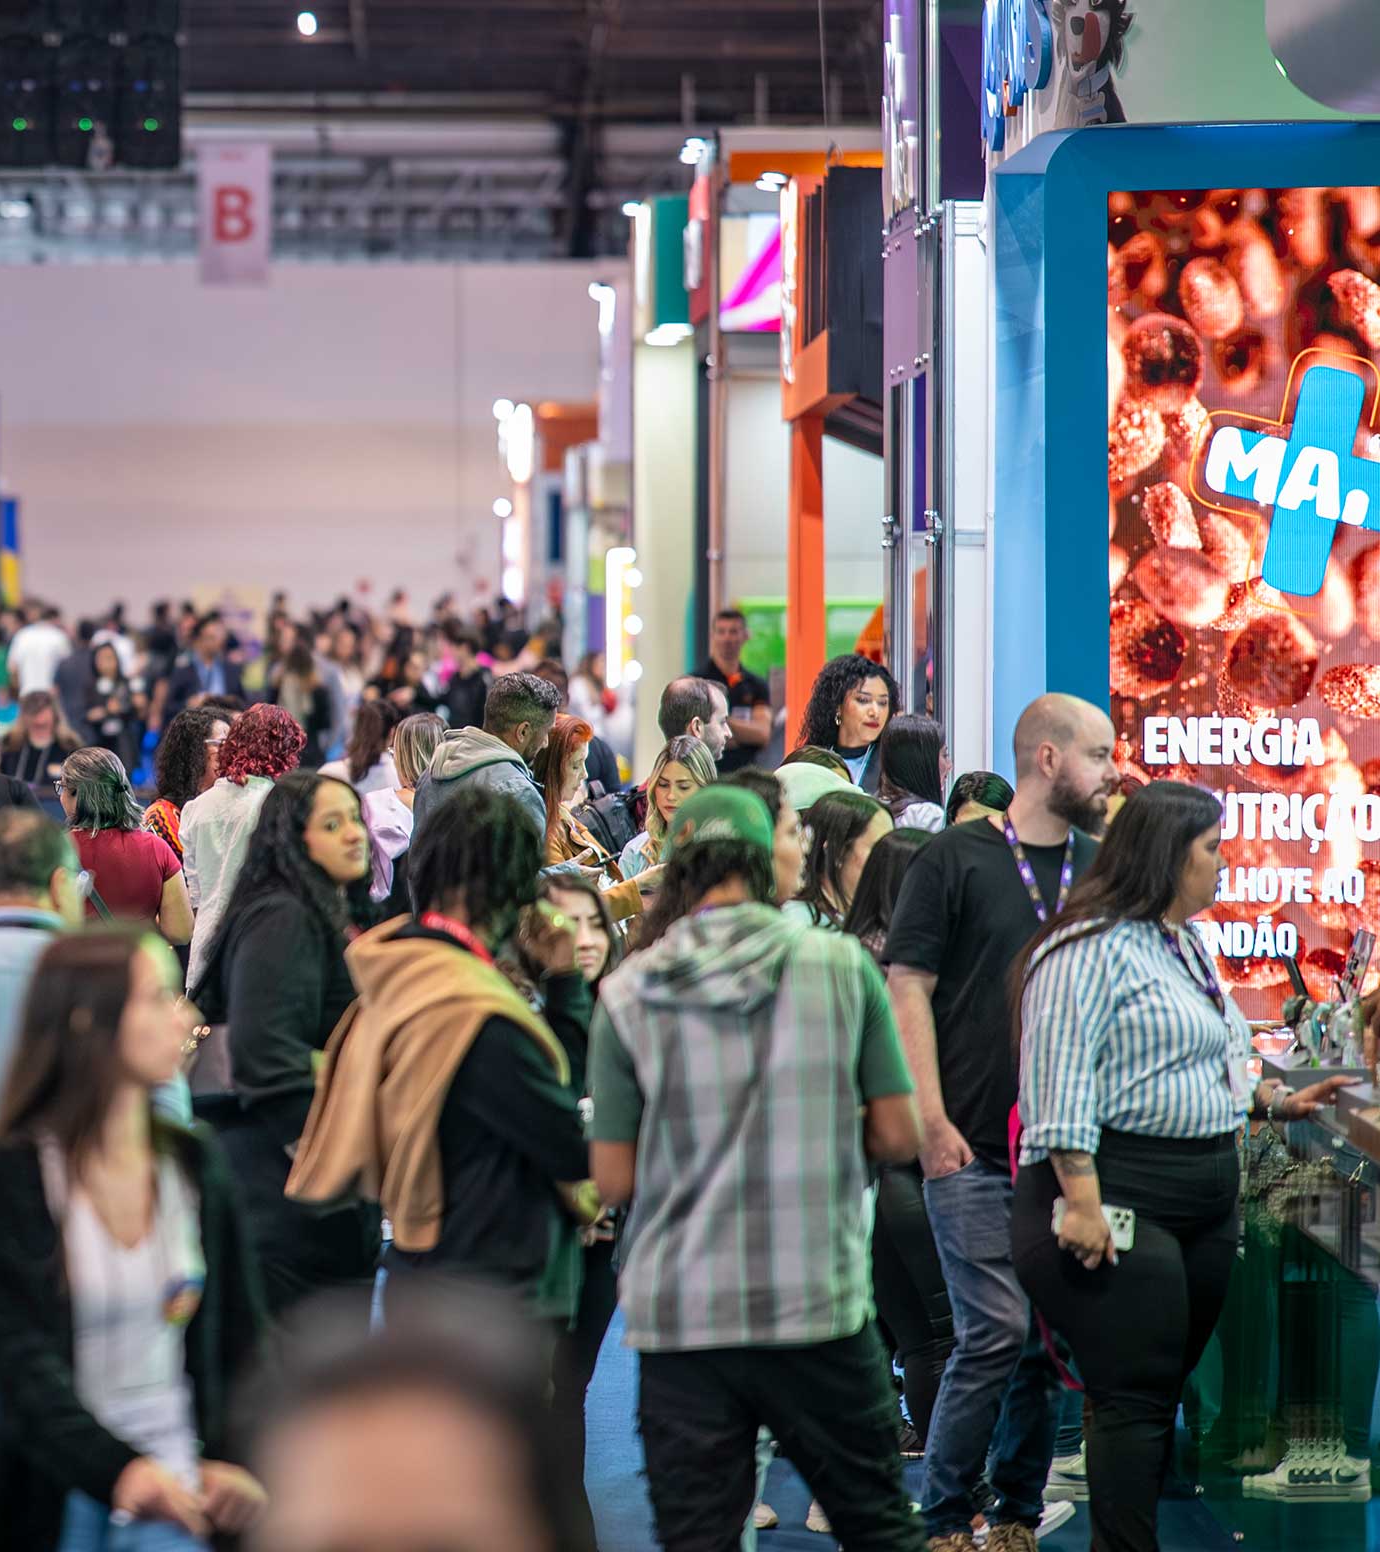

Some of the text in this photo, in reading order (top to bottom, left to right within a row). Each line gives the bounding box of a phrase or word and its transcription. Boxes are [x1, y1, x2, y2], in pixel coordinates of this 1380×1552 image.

[215, 186, 253, 242] B
[1144, 717, 1324, 766] ENERGIA
[1212, 784, 1380, 853] UTRIÇÃO
[1214, 866, 1312, 902] LHOTE
